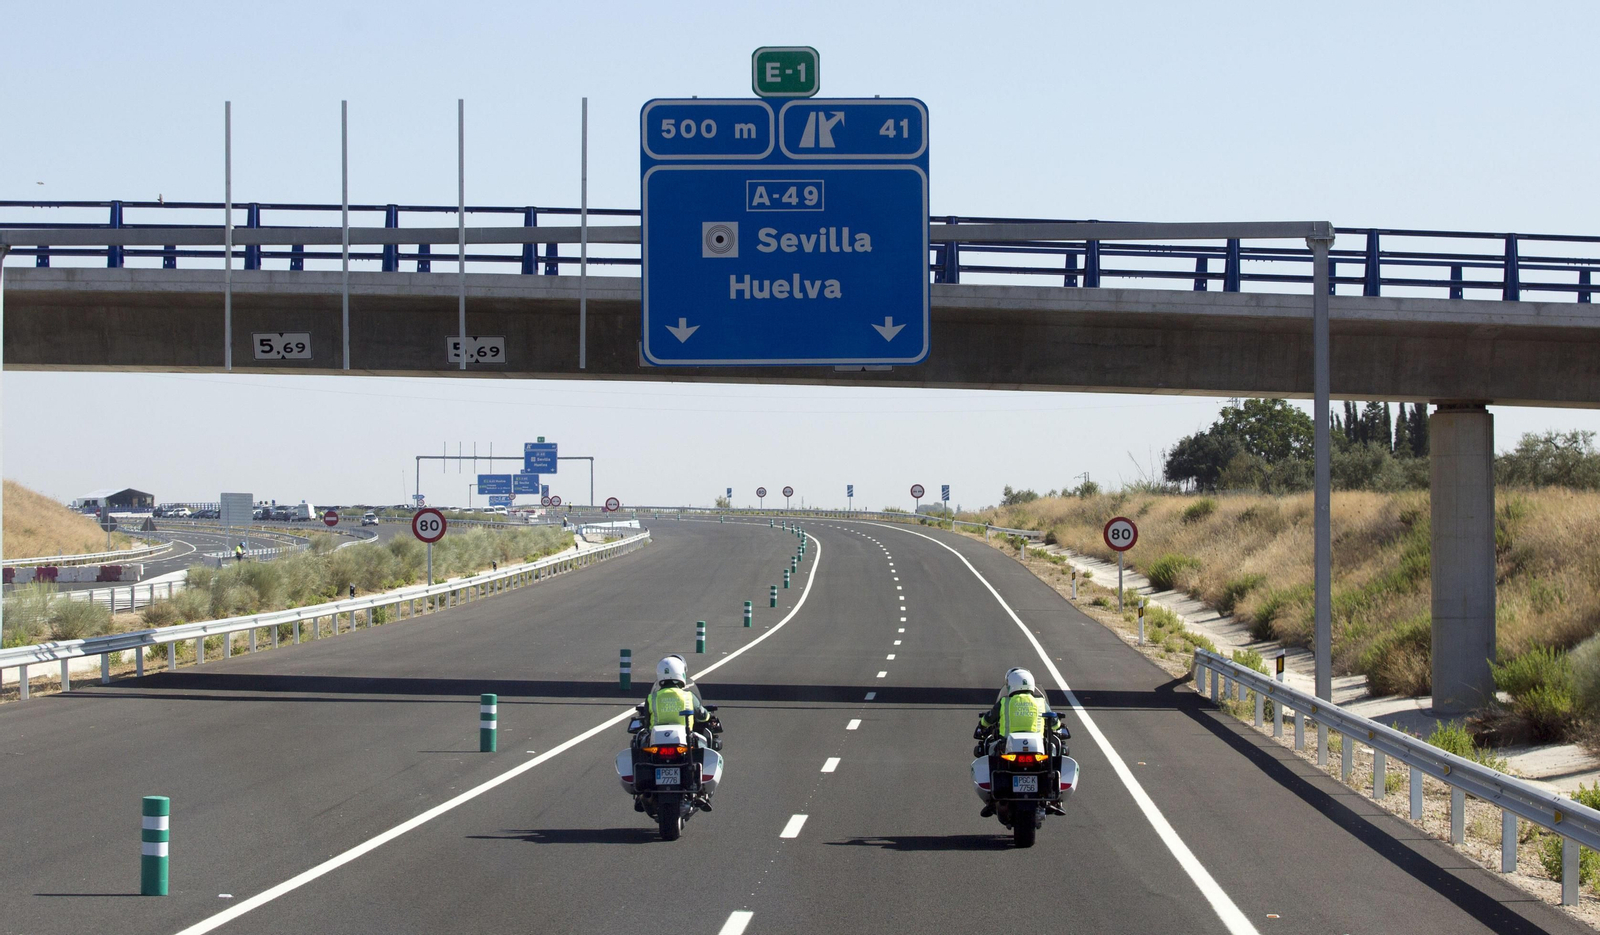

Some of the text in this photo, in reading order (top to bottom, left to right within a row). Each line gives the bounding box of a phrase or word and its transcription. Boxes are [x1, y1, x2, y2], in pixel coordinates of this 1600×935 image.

[766, 62, 806, 82] E-1
[661, 119, 756, 139] 500 m
[879, 118, 909, 139] 41
[751, 186, 819, 206] A-49
[756, 226, 873, 253] Sevilla
[729, 273, 842, 299] Huelva
[259, 338, 306, 355] 5,69
[420, 520, 439, 531] 80
[1111, 528, 1131, 540] 80
